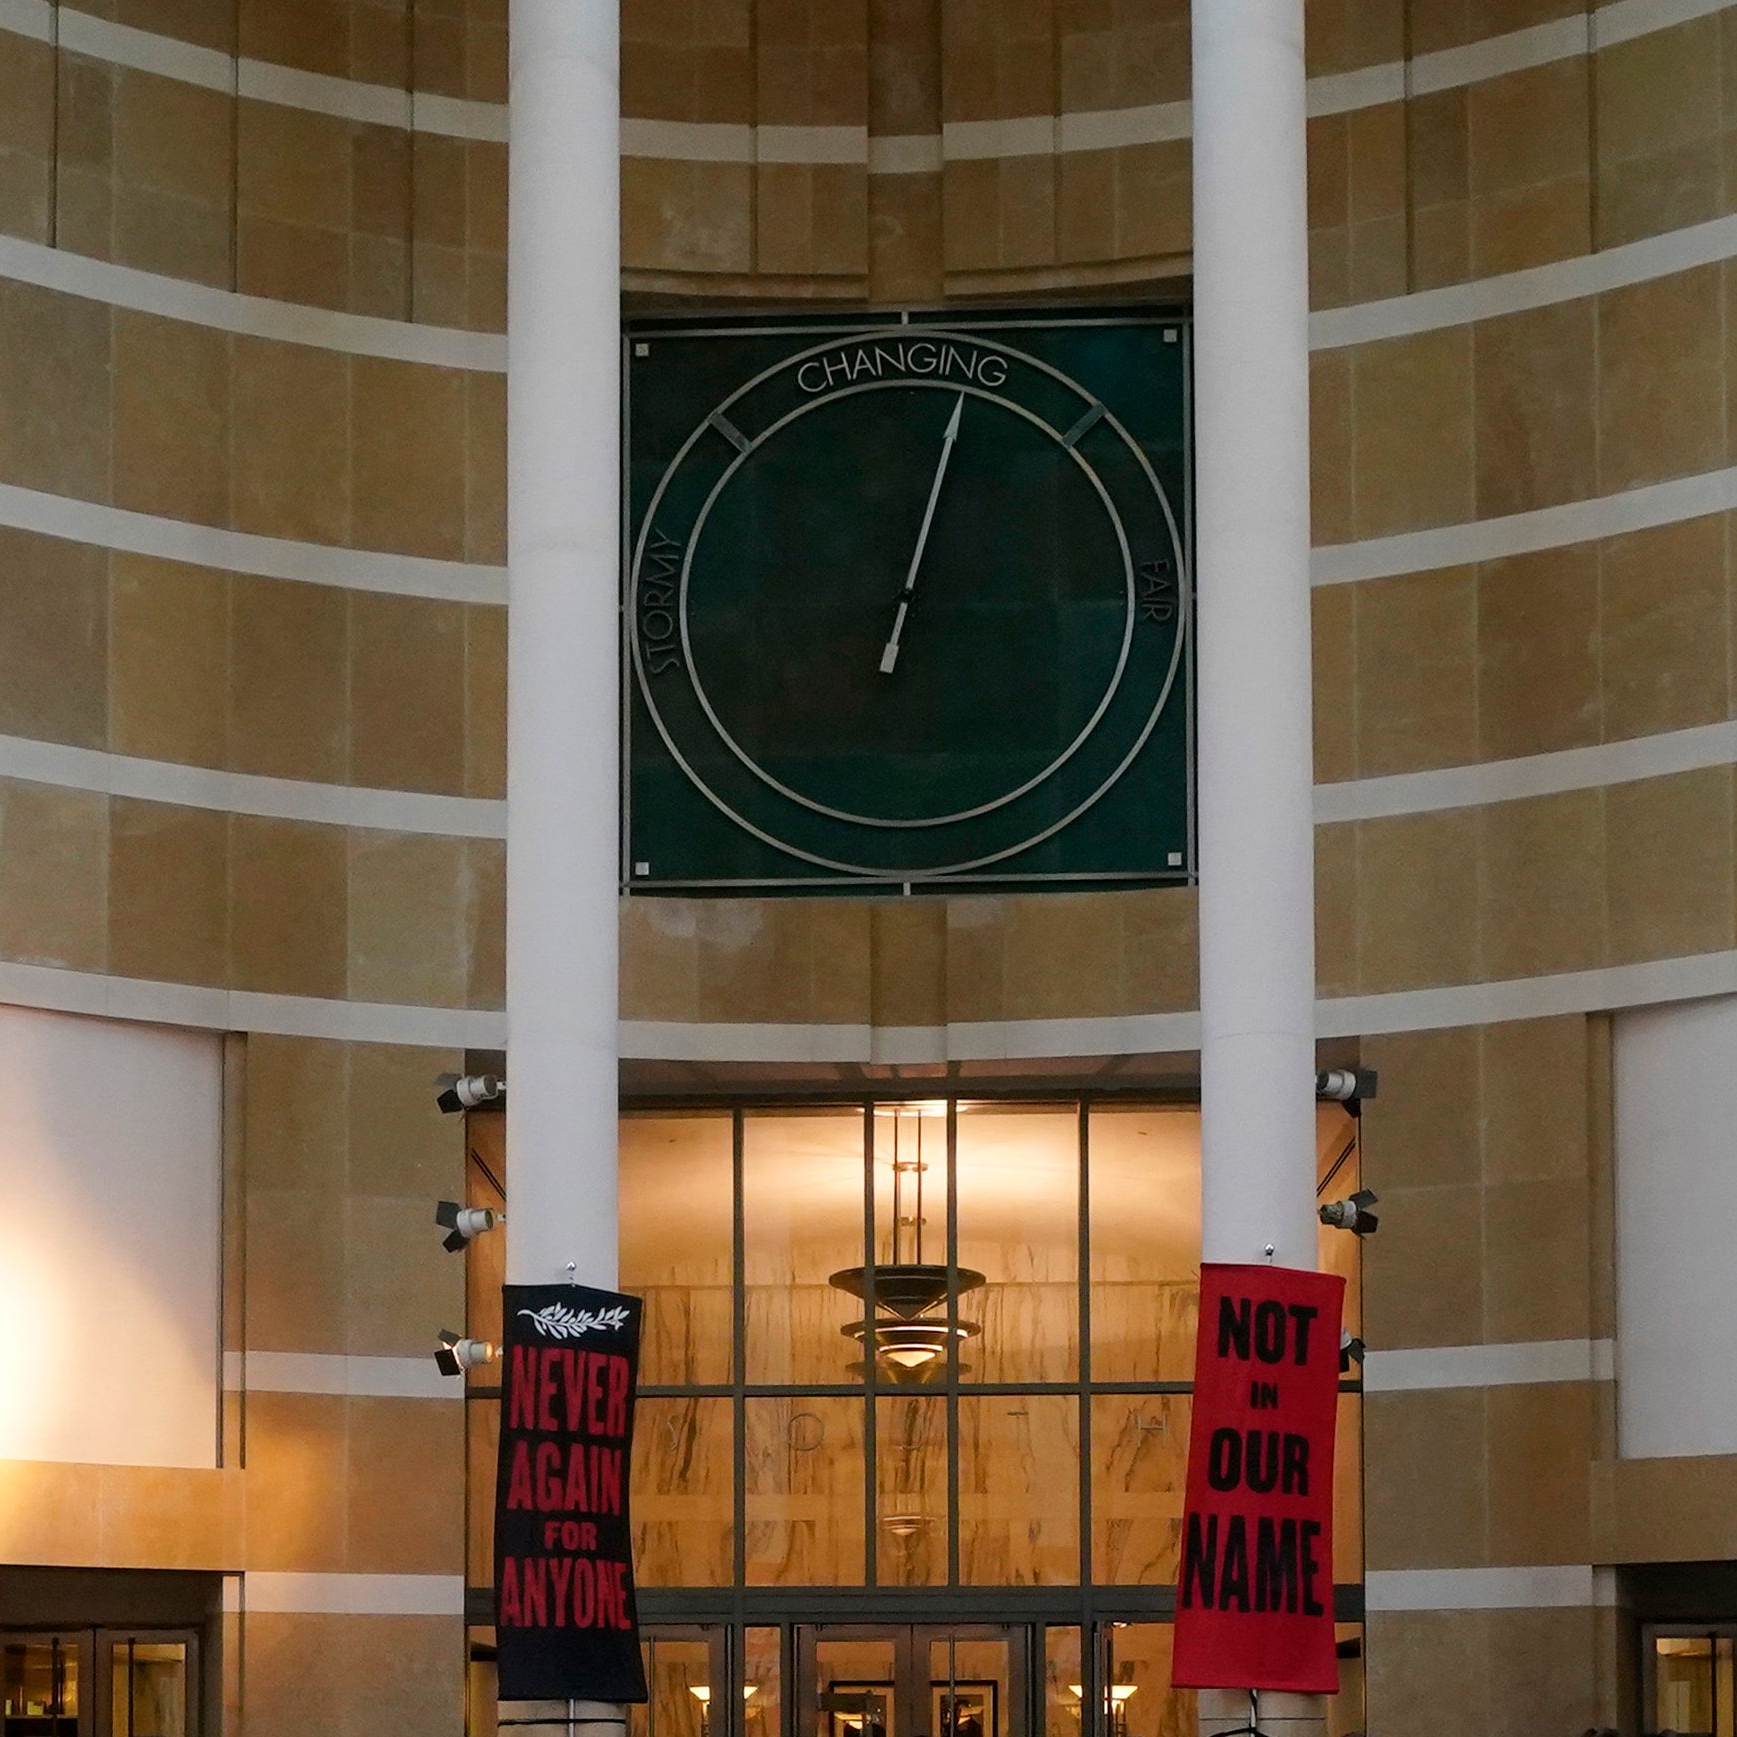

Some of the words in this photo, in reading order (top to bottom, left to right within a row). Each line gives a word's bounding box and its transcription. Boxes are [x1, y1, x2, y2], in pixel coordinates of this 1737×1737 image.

[797, 342, 1008, 394] CHANGING
[642, 529, 683, 676] STORMY
[1140, 557, 1173, 625] FAIR
[1217, 1296, 1318, 1366] NOT
[509, 1344, 629, 1437] NEVER
[1250, 1380, 1279, 1410] IN
[506, 1440, 622, 1516] AGAIN
[1208, 1427, 1310, 1497] OUR
[543, 1521, 598, 1551] FOR
[1182, 1512, 1324, 1617] NAME
[499, 1556, 632, 1630] ANYONE
